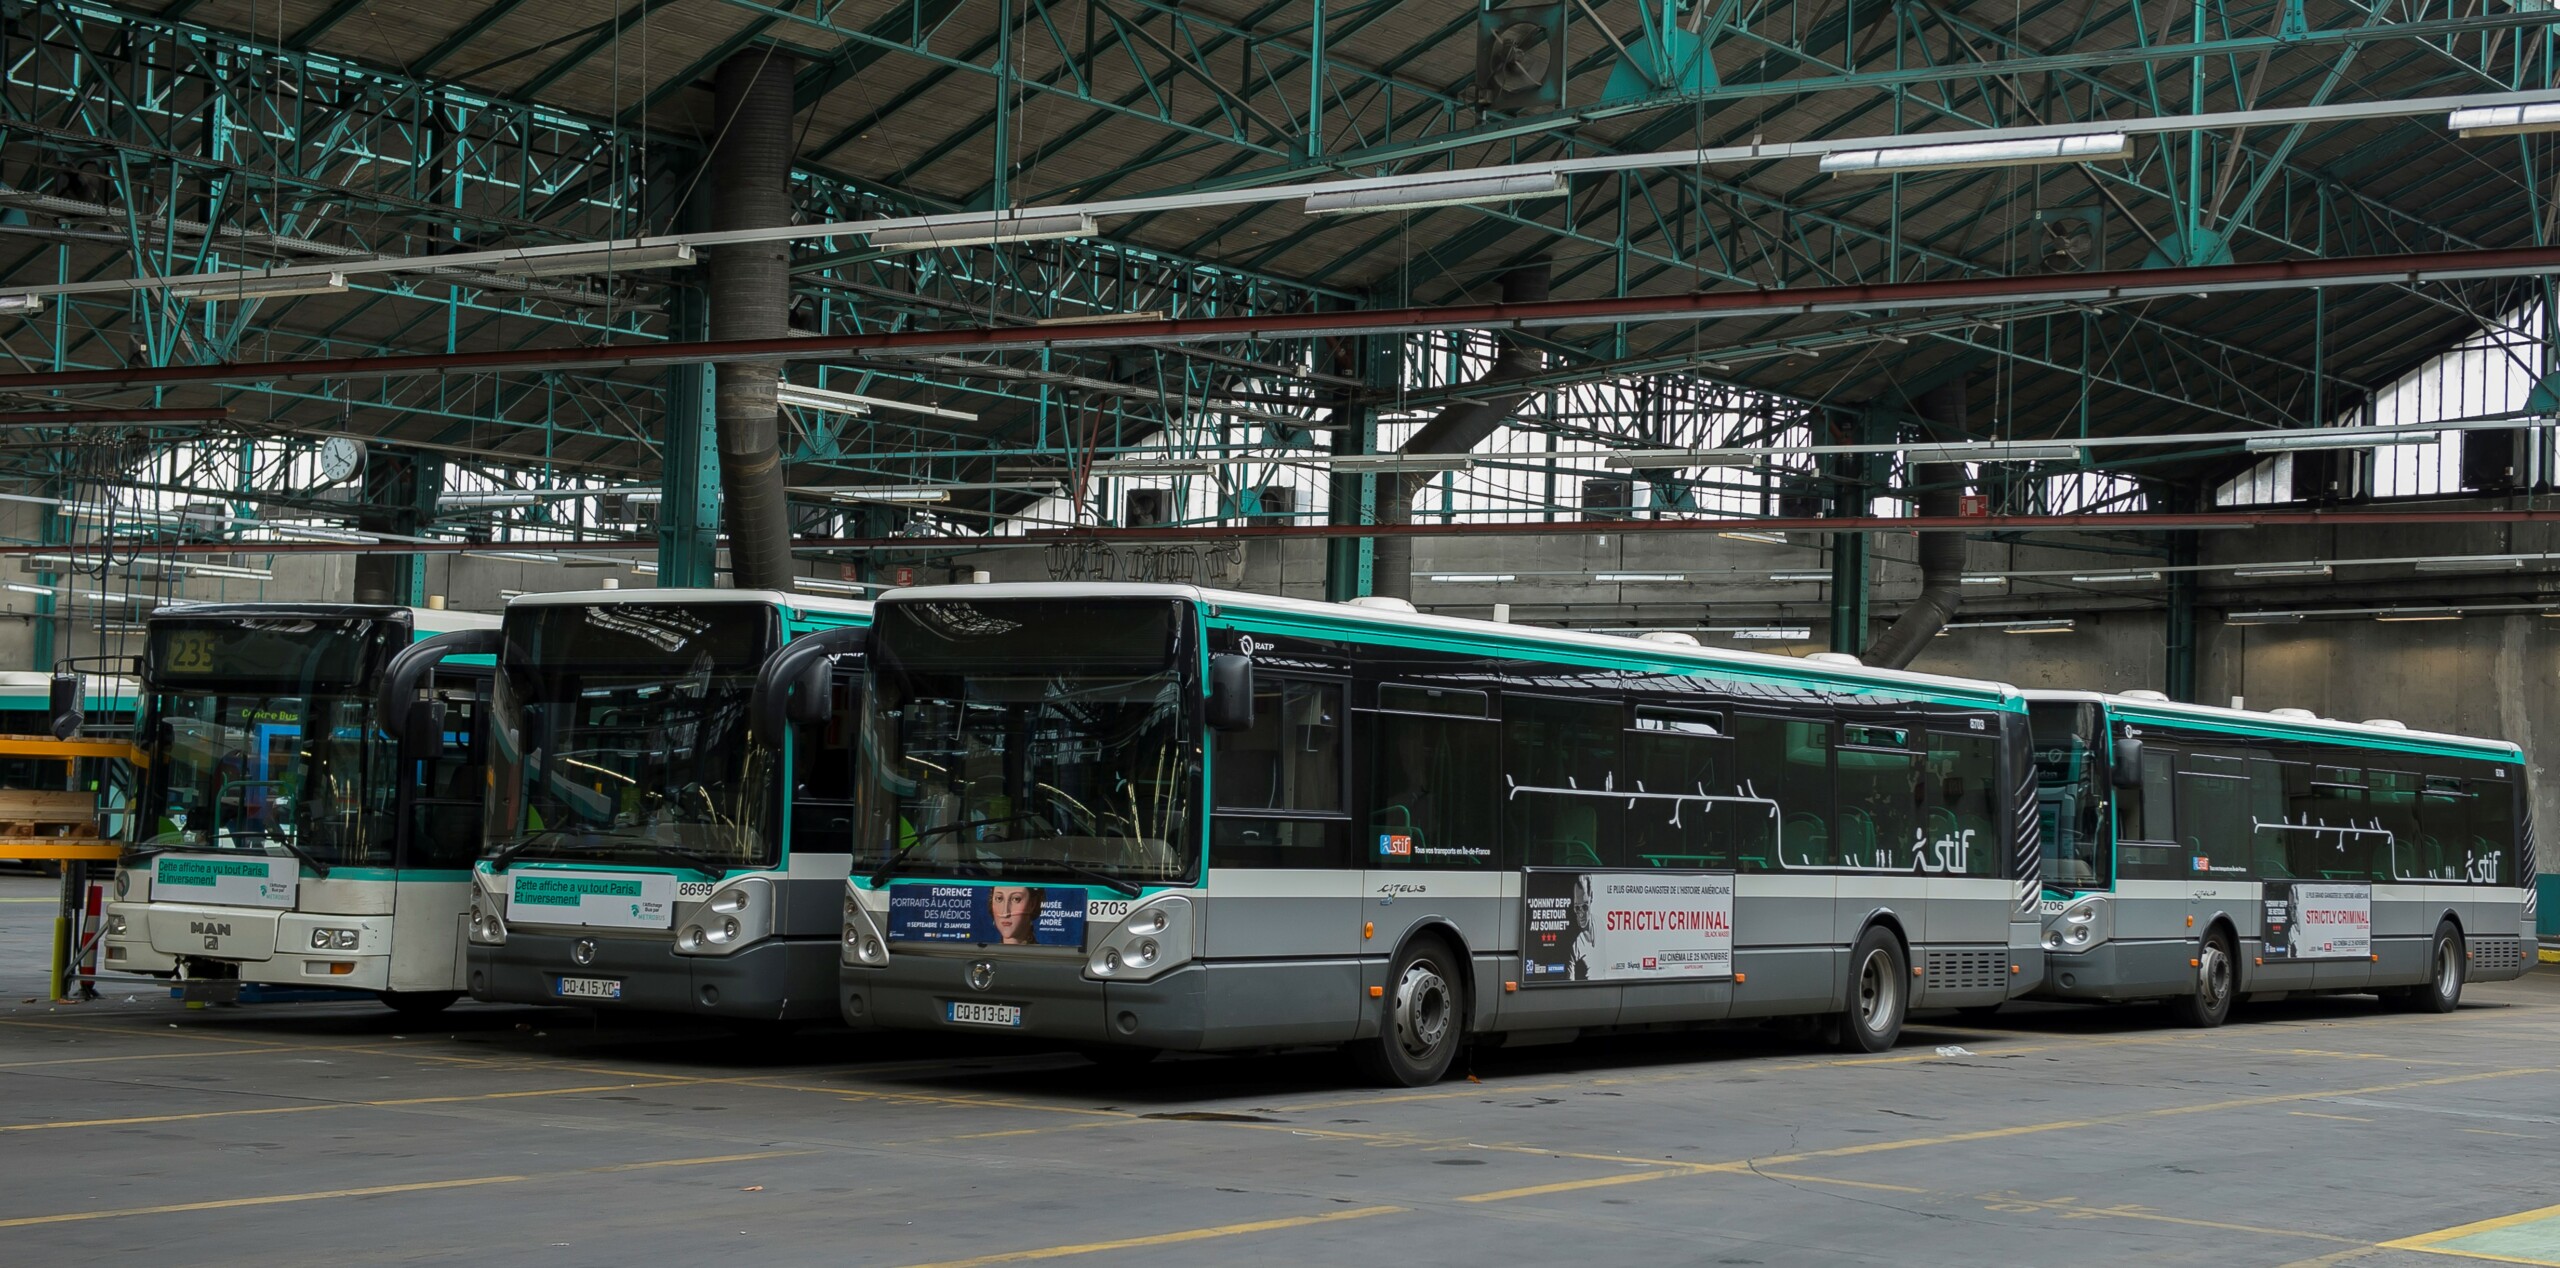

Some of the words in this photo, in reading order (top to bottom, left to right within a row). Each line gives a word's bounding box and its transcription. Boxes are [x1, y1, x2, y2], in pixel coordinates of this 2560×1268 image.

[1254, 642, 1275, 651] RATP
[173, 638, 214, 667] 235
[279, 710, 298, 721] Bus
[1392, 836, 1411, 853] stif
[1934, 829, 1976, 873] stif
[158, 861, 178, 872] Cette
[178, 862, 205, 874] affiche
[213, 865, 222, 875] vu
[224, 864, 241, 875] tout
[242, 865, 265, 877] Paris.
[2478, 850, 2501, 884] stif
[158, 873, 166, 883] Et
[166, 873, 216, 886] inversement.
[515, 879, 538, 891] Cette
[538, 880, 568, 892] affiche
[569, 884, 575, 892] a
[577, 884, 588, 893] vu
[589, 883, 608, 894] tout
[610, 883, 637, 895] Paris.
[679, 882, 714, 896] 8699
[932, 887, 973, 897] FLORENCE
[1606, 885, 1613, 894] LE
[1613, 885, 1625, 894] PLUS
[1625, 885, 1644, 894] GRAND
[1644, 885, 1670, 895] GANGSTER
[1670, 886, 1677, 895] DE
[514, 893, 524, 903] Et
[524, 893, 580, 906] inversement.
[891, 897, 930, 908] PORTRAITS
[930, 897, 937, 907] À
[937, 899, 948, 908] LA
[948, 899, 972, 908] COUR
[1040, 900, 1063, 909] MUSÉE
[1555, 898, 1571, 908] DEPP
[1089, 901, 1129, 916] 8703
[2040, 901, 2064, 910] 706
[924, 910, 939, 919] DES
[940, 908, 971, 920] MÉDICIS
[1039, 910, 1083, 918] JACQUEMART
[1532, 909, 1542, 920] DE
[1541, 909, 1567, 920] RETOUR
[2305, 909, 2337, 924] STRICTLY
[2338, 909, 2369, 924] CRIMINAL
[911, 921, 938, 929] SEPTEMBRE
[1039, 918, 1063, 926] ANDRÉ
[1530, 921, 1540, 931] AU
[1606, 910, 1667, 931] STRICTLY
[1668, 910, 1730, 931] CRIMINAL
[190, 921, 231, 936] MAN
[1659, 952, 1667, 962] AU
[1667, 951, 1686, 961] CINÉMA
[1686, 952, 1693, 961] LE
[1693, 952, 1700, 961] 25
[1700, 951, 1729, 961] NOVEMBRE
